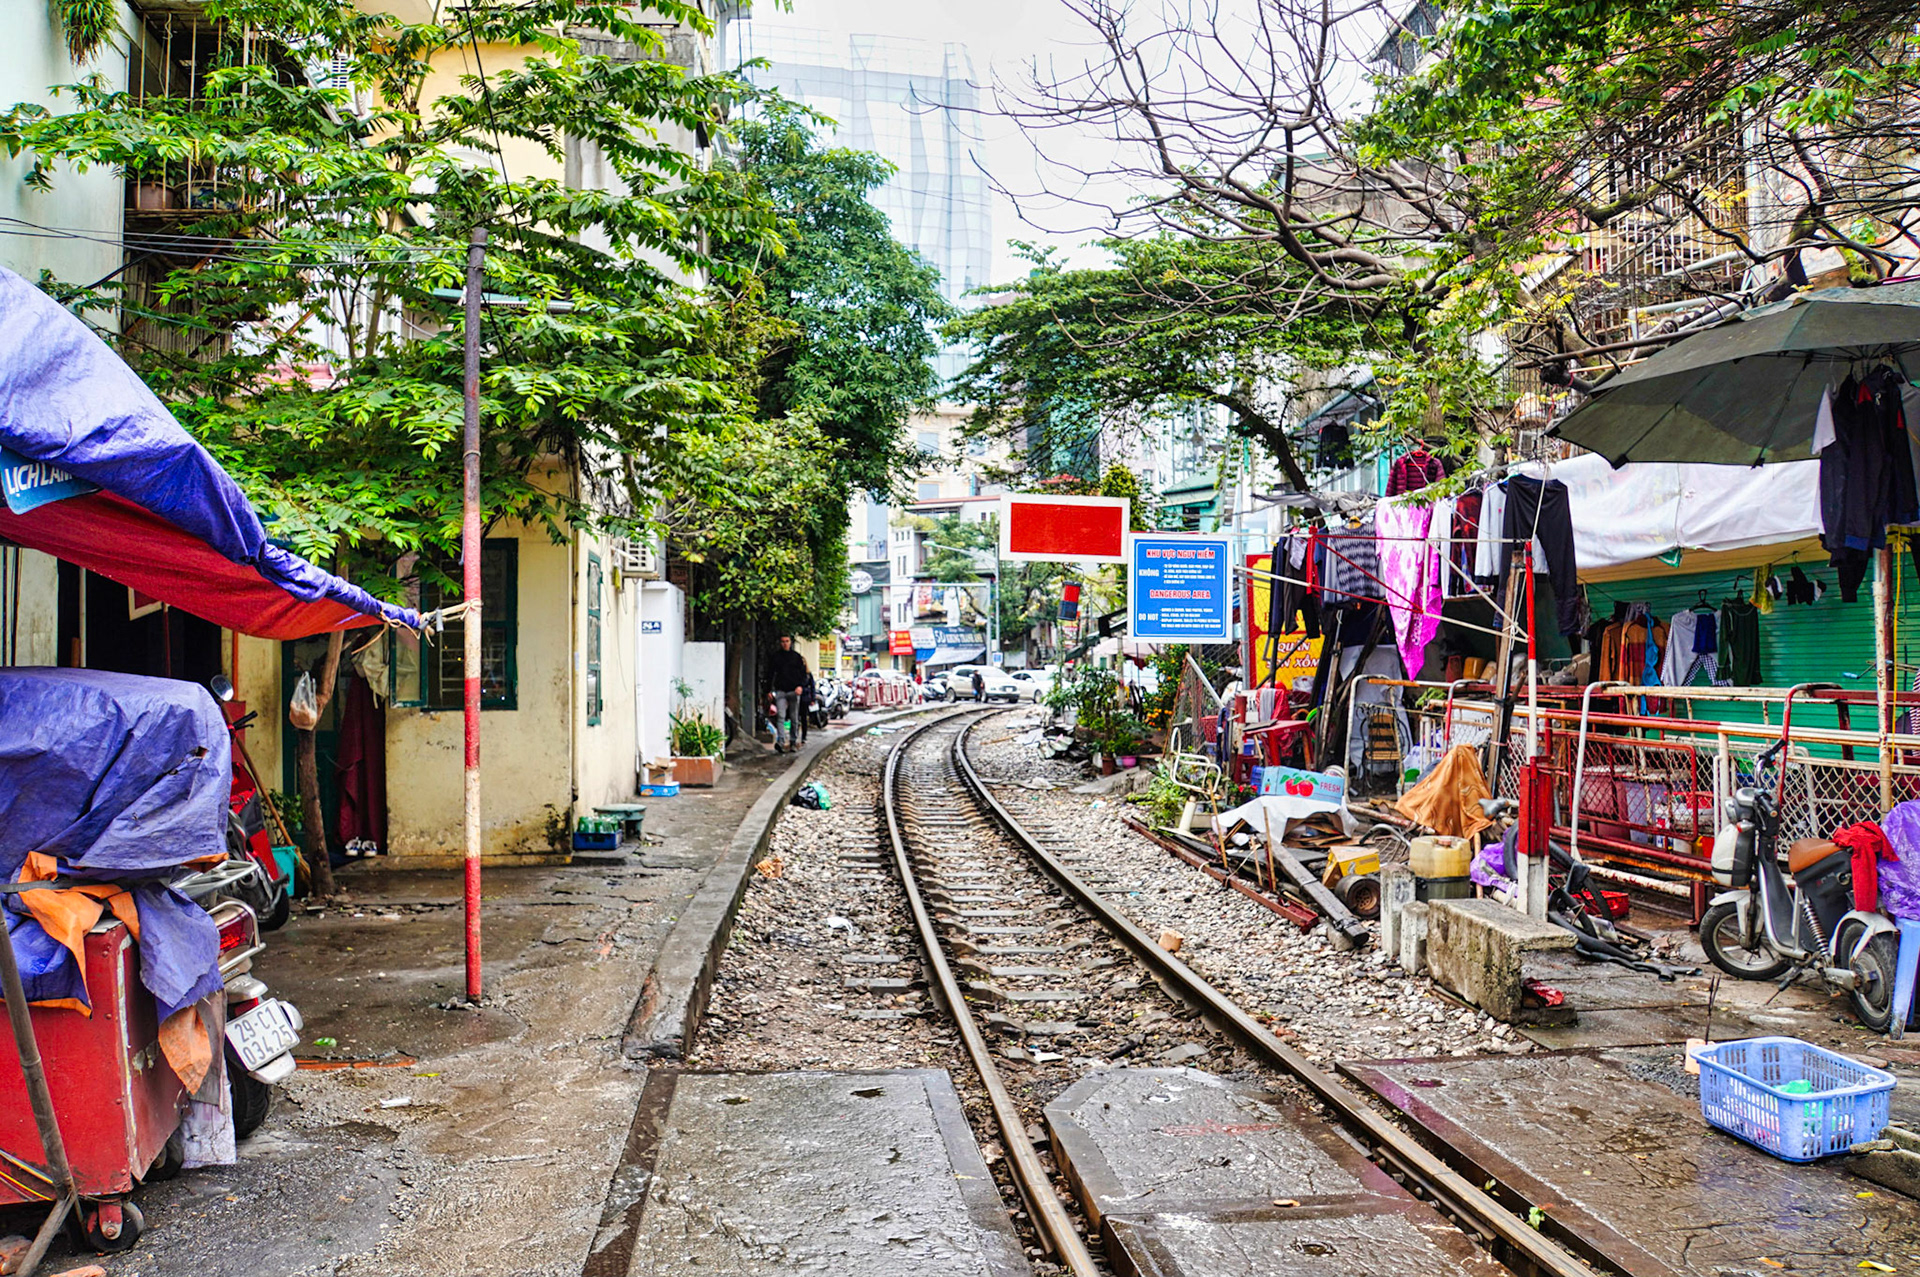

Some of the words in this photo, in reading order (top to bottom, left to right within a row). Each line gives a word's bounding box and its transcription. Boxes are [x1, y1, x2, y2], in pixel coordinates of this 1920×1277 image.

[1146, 549, 1161, 558] KHU
[1177, 550, 1196, 559] NGUY
[1149, 589, 1191, 599] DANGEROUS
[1192, 590, 1211, 599] AREA
[1138, 613, 1147, 621] DO
[1147, 613, 1159, 621] NOT
[1320, 782, 1341, 793] FRESH
[234, 1007, 278, 1043] 29-C1
[242, 1025, 293, 1065] 034.25
